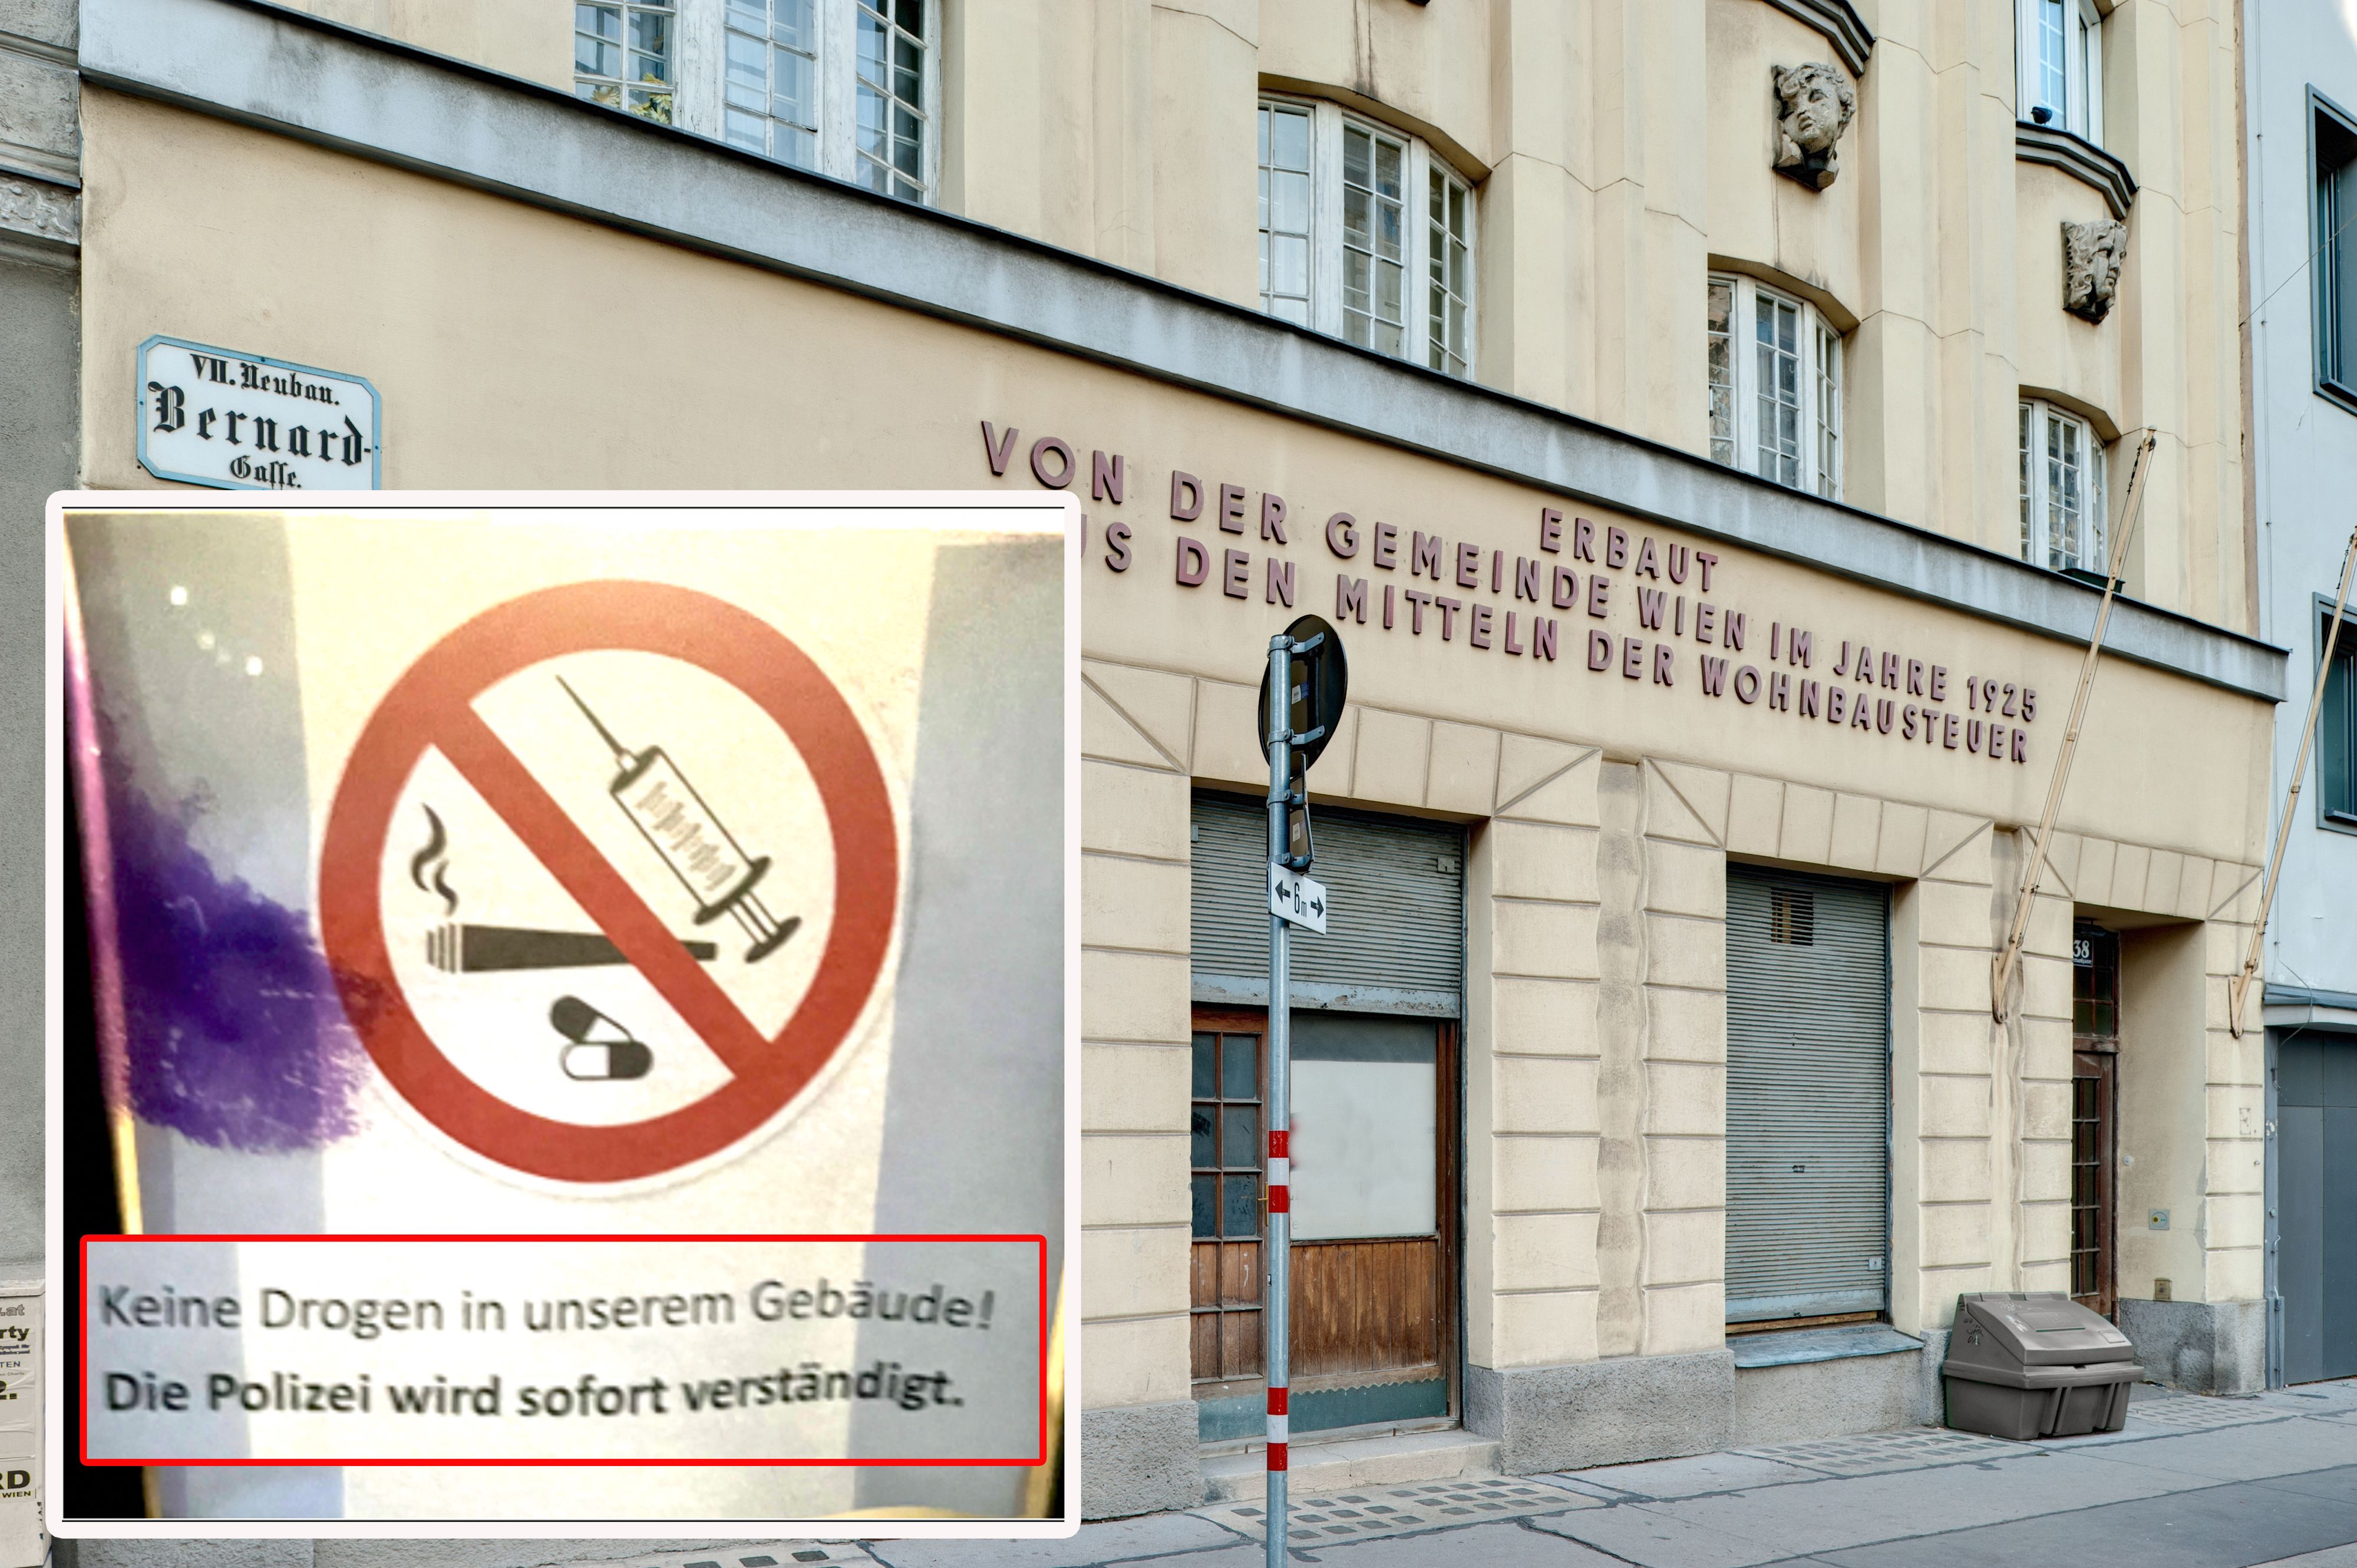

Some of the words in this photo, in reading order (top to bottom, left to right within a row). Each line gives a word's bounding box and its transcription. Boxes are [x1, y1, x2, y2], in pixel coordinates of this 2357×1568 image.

[190, 354, 235, 385] VII.
[240, 362, 340, 405] Neubau.
[148, 381, 371, 466] Bernard-
[981, 421, 1124, 504] VON
[1170, 470, 1287, 545] DER
[1326, 511, 1610, 620] GEMEINDE
[1638, 586, 1746, 651] WIEN
[1771, 622, 1812, 668] IM
[1834, 641, 1947, 702] JAHRE
[1968, 676, 2037, 722] 1925
[1541, 508, 1719, 592] ERBAUT
[1081, 514, 1133, 573] S
[1176, 536, 1295, 608] DEN
[1336, 574, 1558, 661] MITTELN
[1588, 629, 1675, 686] DER
[1701, 654, 2027, 764] WOHNBAUSTEUER
[2074, 939, 2089, 958] 38
[0, 1303, 25, 1316] .at
[98, 1284, 242, 1328] Keine
[259, 1287, 444, 1341] Drogen
[461, 1290, 506, 1332] in
[523, 1289, 736, 1332] unserem
[750, 1277, 995, 1330] Gebäude!
[103, 1371, 191, 1412] Die
[206, 1371, 371, 1414] Polizei
[385, 1375, 503, 1418] wird
[516, 1374, 666, 1418] sofort
[681, 1361, 965, 1412] verständigt.
[0, 1470, 31, 1490] D
